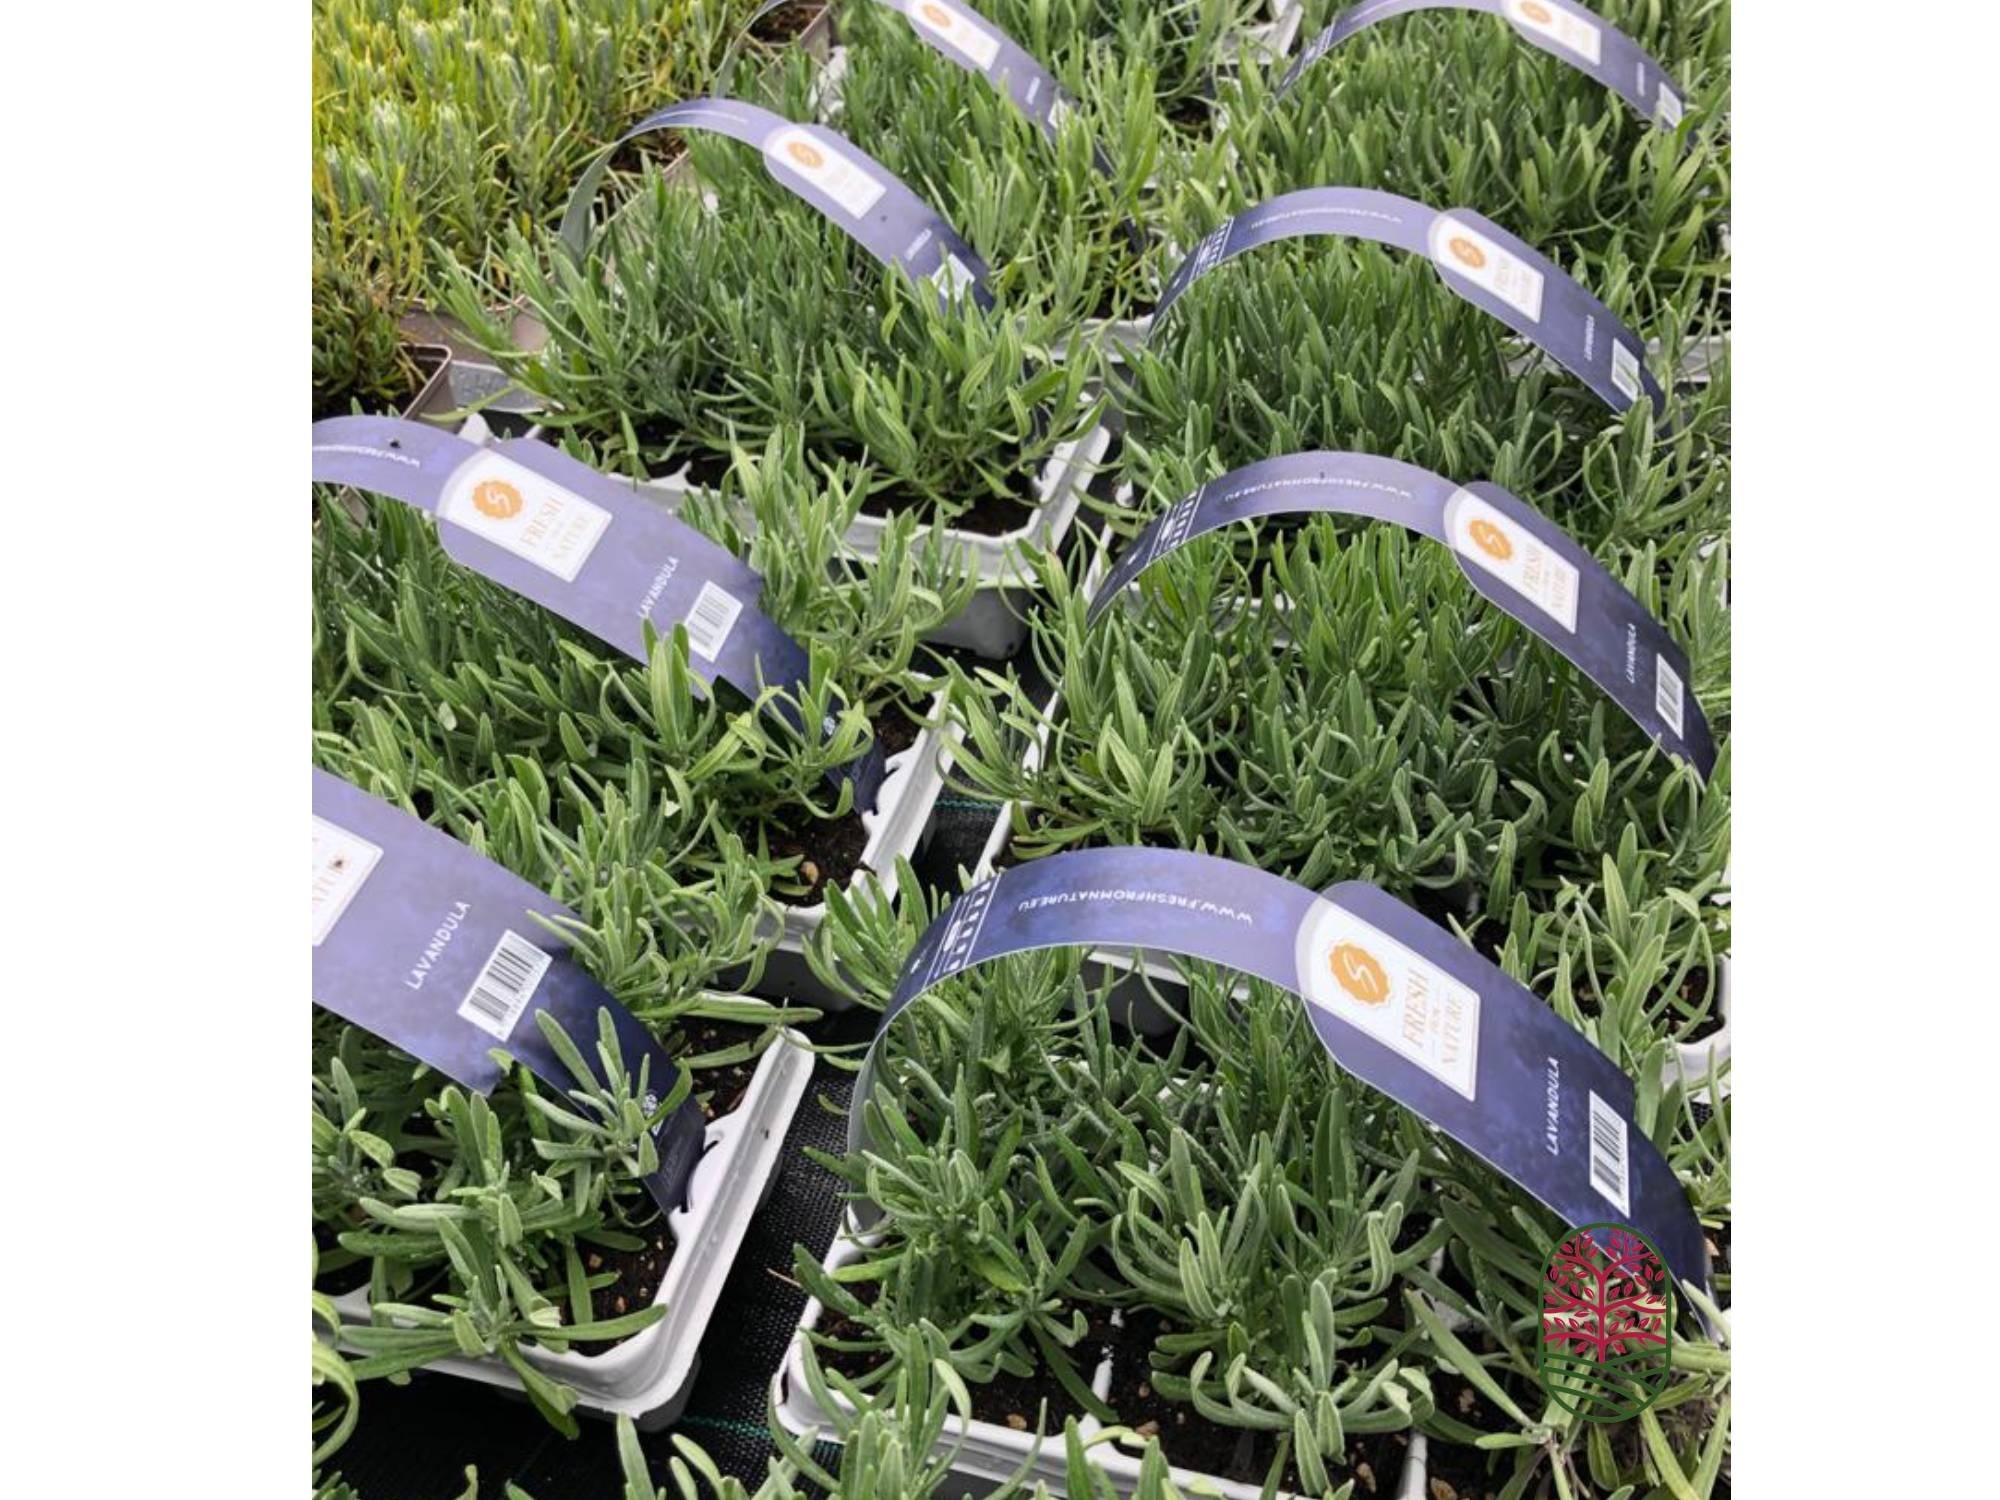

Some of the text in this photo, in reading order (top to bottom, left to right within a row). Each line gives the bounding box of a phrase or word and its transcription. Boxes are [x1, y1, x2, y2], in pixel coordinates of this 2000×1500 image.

[402, 900, 472, 990] LAVANDULA
[1018, 889, 1253, 925] WWW.FRESHFROMNATURE.EU
[1402, 967, 1429, 1048] FRESH
[1546, 1056, 1560, 1157] LAVANDULA
